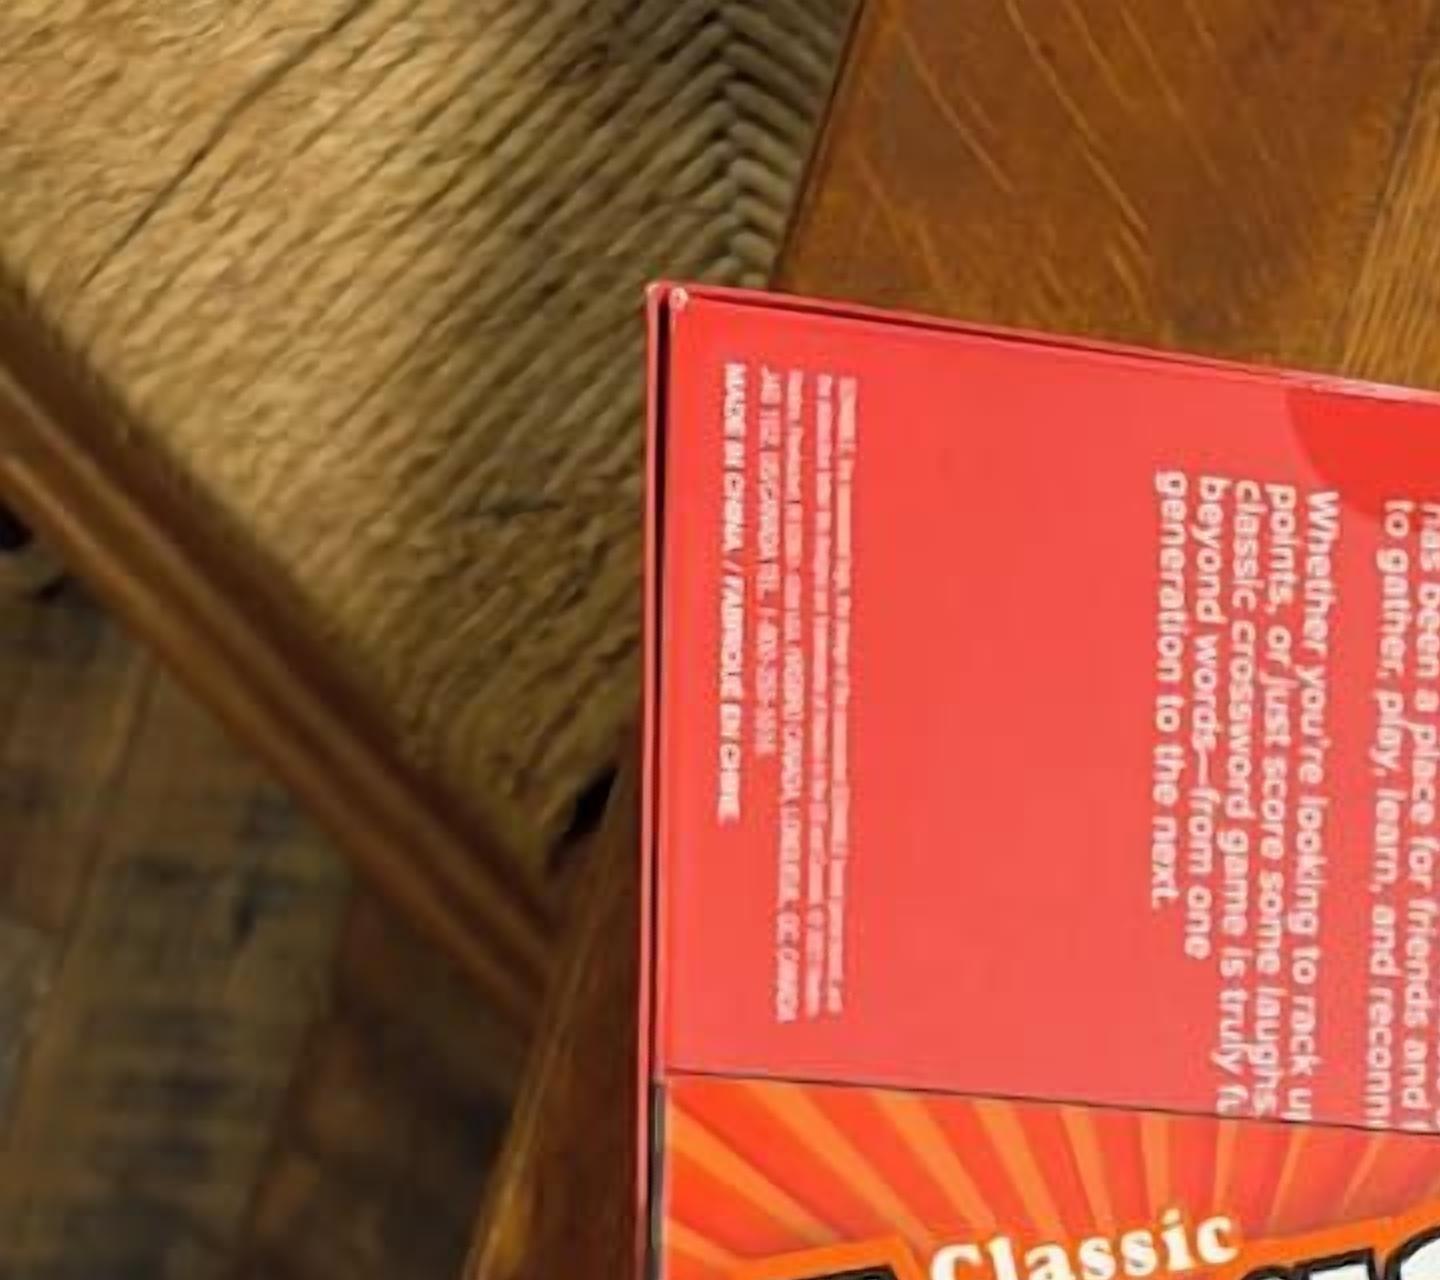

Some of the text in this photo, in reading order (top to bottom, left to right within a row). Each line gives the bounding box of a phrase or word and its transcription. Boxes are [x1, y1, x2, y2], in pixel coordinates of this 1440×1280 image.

[1191, 476, 1230, 623] beyond
[1233, 480, 1265, 612] classic
[1265, 484, 1297, 615] points,
[1385, 500, 1412, 537] to
[1303, 492, 1340, 655] Whether
[1377, 550, 1411, 678] gather,
[1152, 471, 1188, 909] generation to the next.
[1267, 625, 1293, 668] or
[1226, 620, 1254, 818] crossword
[1259, 672, 1298, 747] just
[1295, 666, 1330, 784] you're
[1369, 691, 1407, 775] play,
[1415, 690, 1439, 711] a
[1261, 756, 1287, 860] score
[1402, 722, 1440, 825] place
[1218, 829, 1250, 936] game
[1288, 796, 1328, 935] looking
[1369, 789, 1406, 892] learn,
[1409, 836, 1440, 891] for
[1185, 886, 1211, 960] one
[1220, 947, 1251, 977] is
[1258, 870, 1284, 975] some
[1292, 949, 1321, 984] to
[1370, 905, 1400, 976] and
[1405, 900, 1437, 1027] friends
[1211, 988, 1248, 1076] truly
[1290, 997, 1321, 1076] rack
[1402, 1040, 1429, 1108] and
